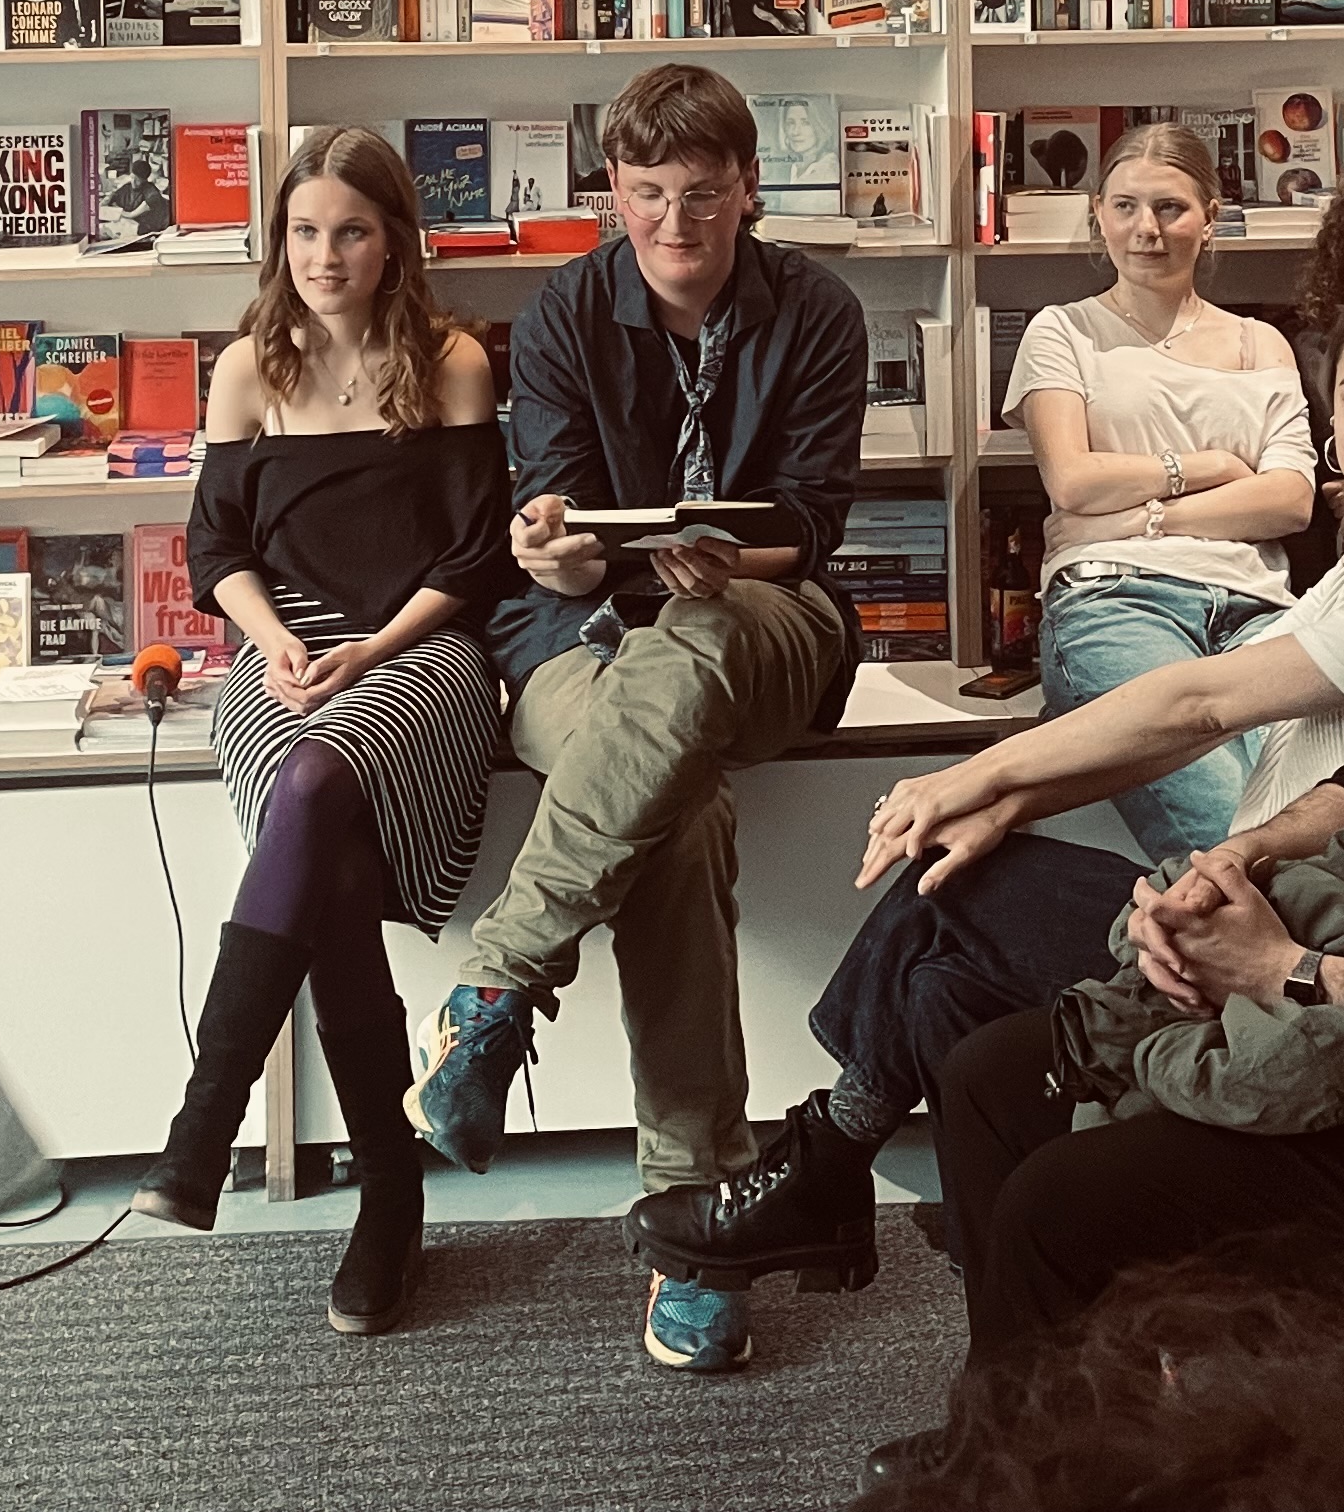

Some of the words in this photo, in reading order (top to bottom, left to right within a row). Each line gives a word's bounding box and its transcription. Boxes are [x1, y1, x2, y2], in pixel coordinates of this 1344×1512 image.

[10, 1, 62, 16] LEONARD
[318, 0, 333, 11] DER
[335, 0, 372, 11] GROSSE
[11, 16, 58, 30] COHENS
[328, 10, 362, 22] GATSBY
[11, 30, 57, 45] STIMME
[414, 121, 443, 132] ANDRÉ
[445, 123, 484, 132] ACIMAN
[56, 337, 97, 352] DANIEL
[45, 350, 107, 365] SCHREIBER
[40, 619, 56, 632] DIE
[59, 616, 102, 631] BÄRTIGE
[156, 604, 215, 637] frau
[40, 633, 67, 646] FRAU
